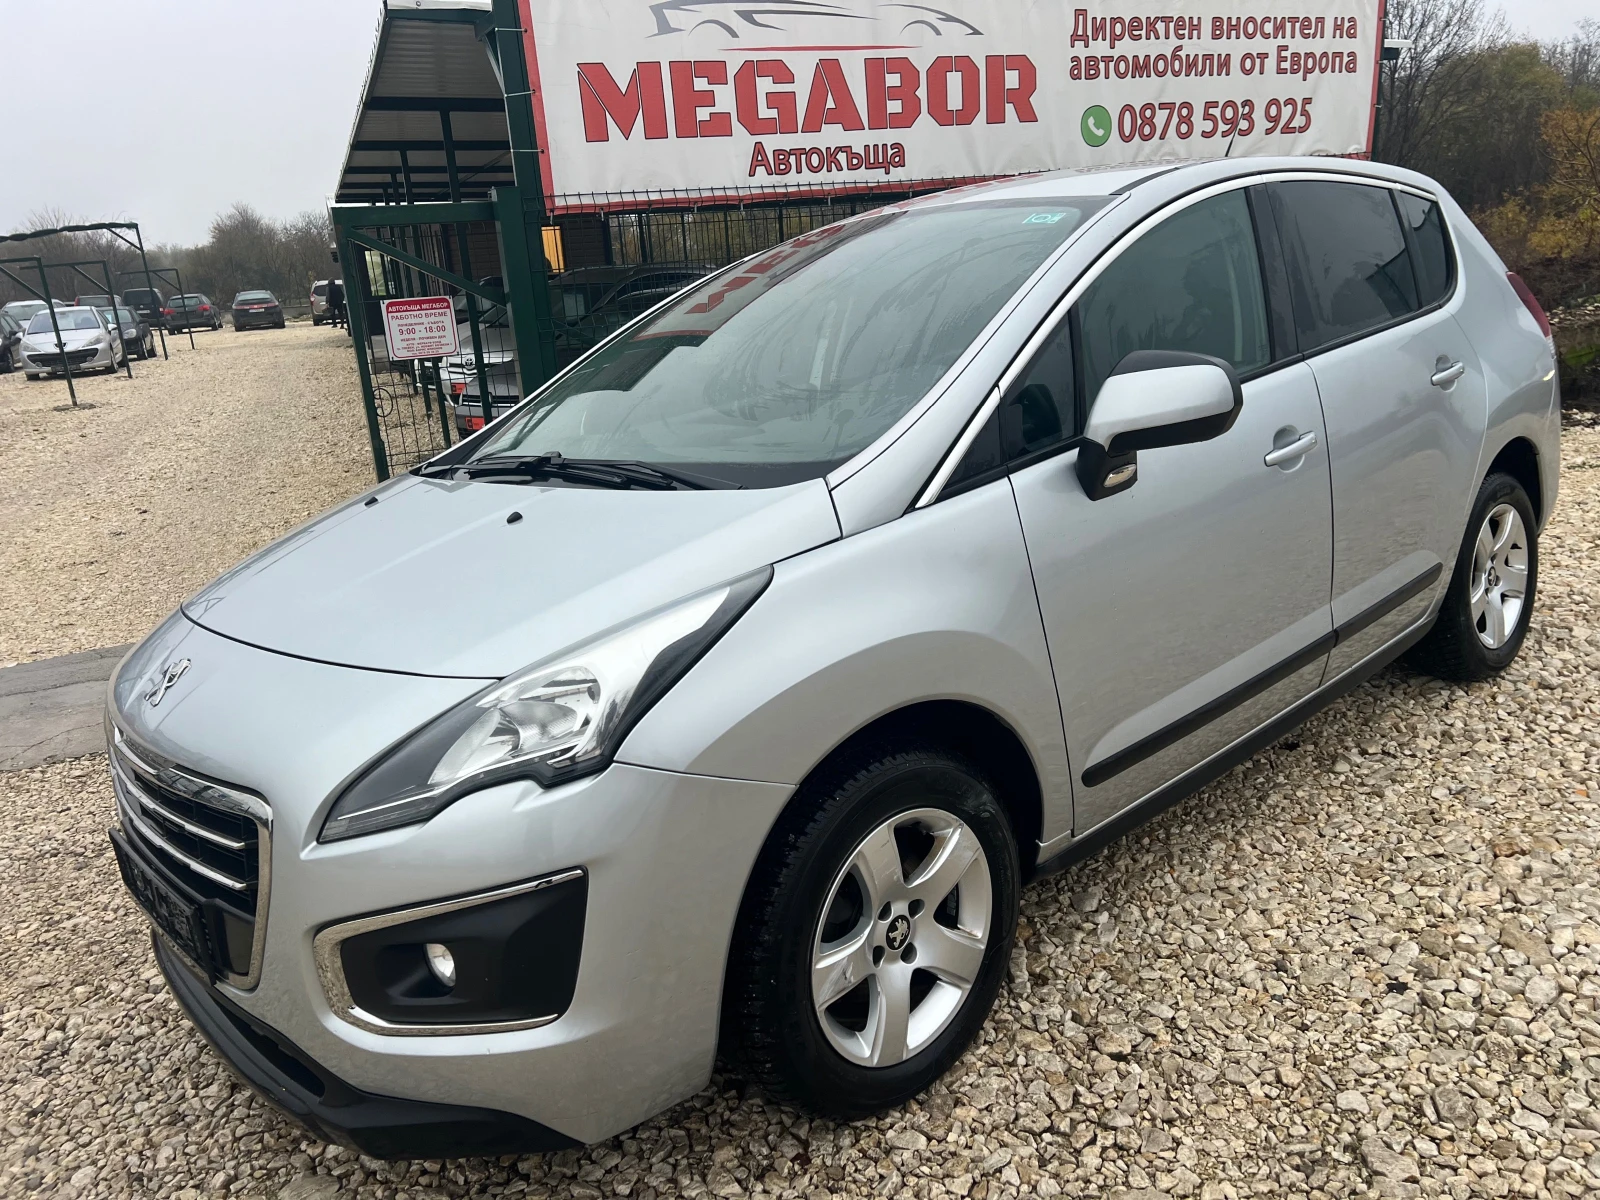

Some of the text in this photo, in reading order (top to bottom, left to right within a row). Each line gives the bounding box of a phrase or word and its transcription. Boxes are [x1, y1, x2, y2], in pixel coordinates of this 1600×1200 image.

[1070, 9, 1358, 49] Директен вносител на
[1069, 45, 1358, 81] автомобили от Европа
[577, 54, 1039, 143] MEGABOR
[1117, 97, 1313, 143] 0878 593 925
[748, 141, 906, 178] Автокъща
[388, 304, 421, 312] АВТОКЪЩА
[391, 311, 448, 321] РАБОТНО ВРЕМЕ
[398, 327, 416, 336] 9:00
[424, 325, 446, 333] 18:00
